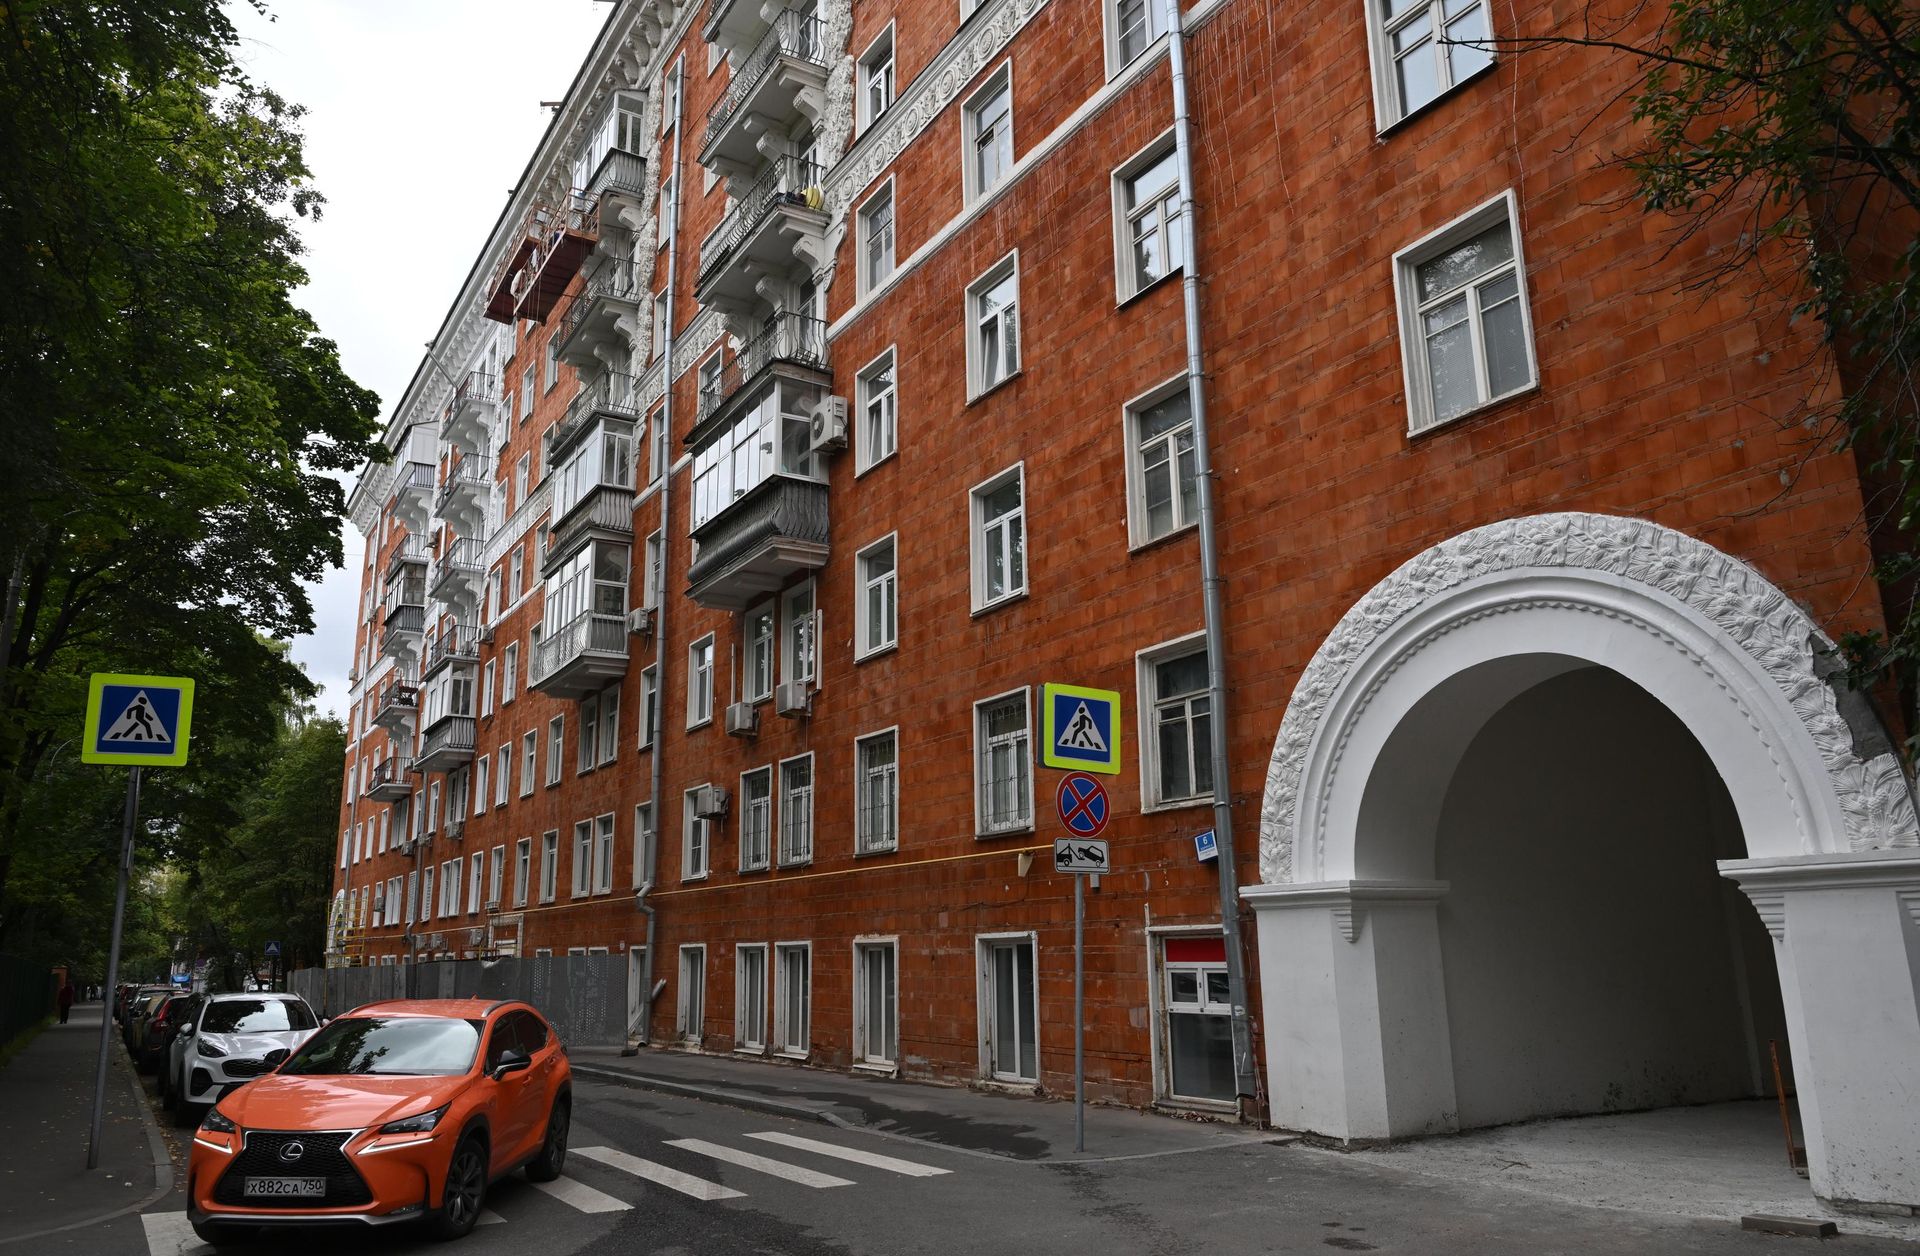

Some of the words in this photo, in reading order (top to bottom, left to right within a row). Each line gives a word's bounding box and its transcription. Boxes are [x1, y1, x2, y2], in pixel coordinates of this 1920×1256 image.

[1202, 836, 1208, 845] 6
[250, 1180, 299, 1194] Х882СА
[302, 1180, 322, 1191] 750
